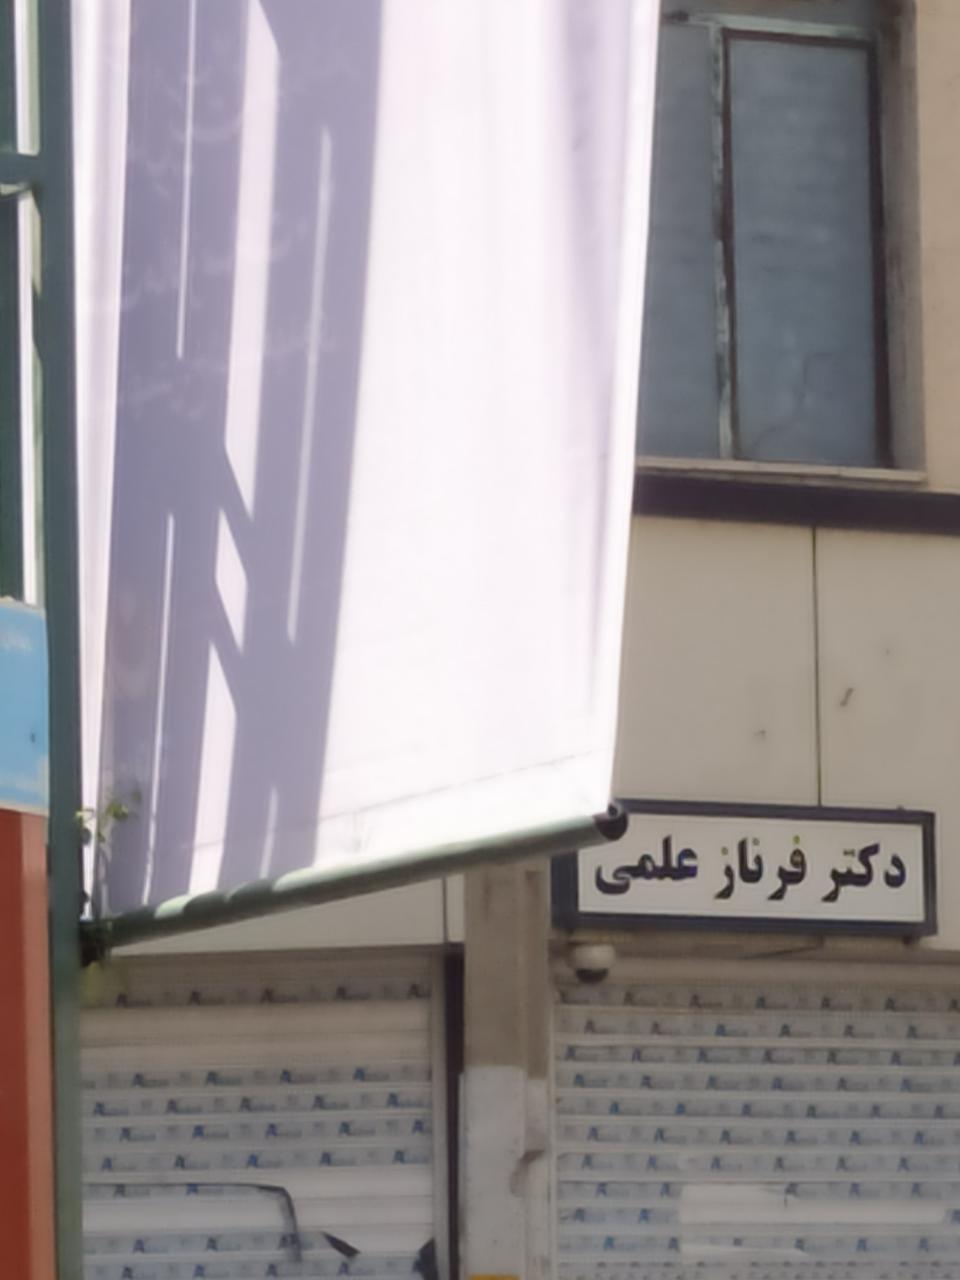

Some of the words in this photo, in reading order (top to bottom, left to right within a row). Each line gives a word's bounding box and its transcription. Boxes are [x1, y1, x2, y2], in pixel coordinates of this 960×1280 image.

[594, 834, 699, 895] علمی
[714, 835, 807, 900] فرناز
[822, 842, 906, 902] دکتر
